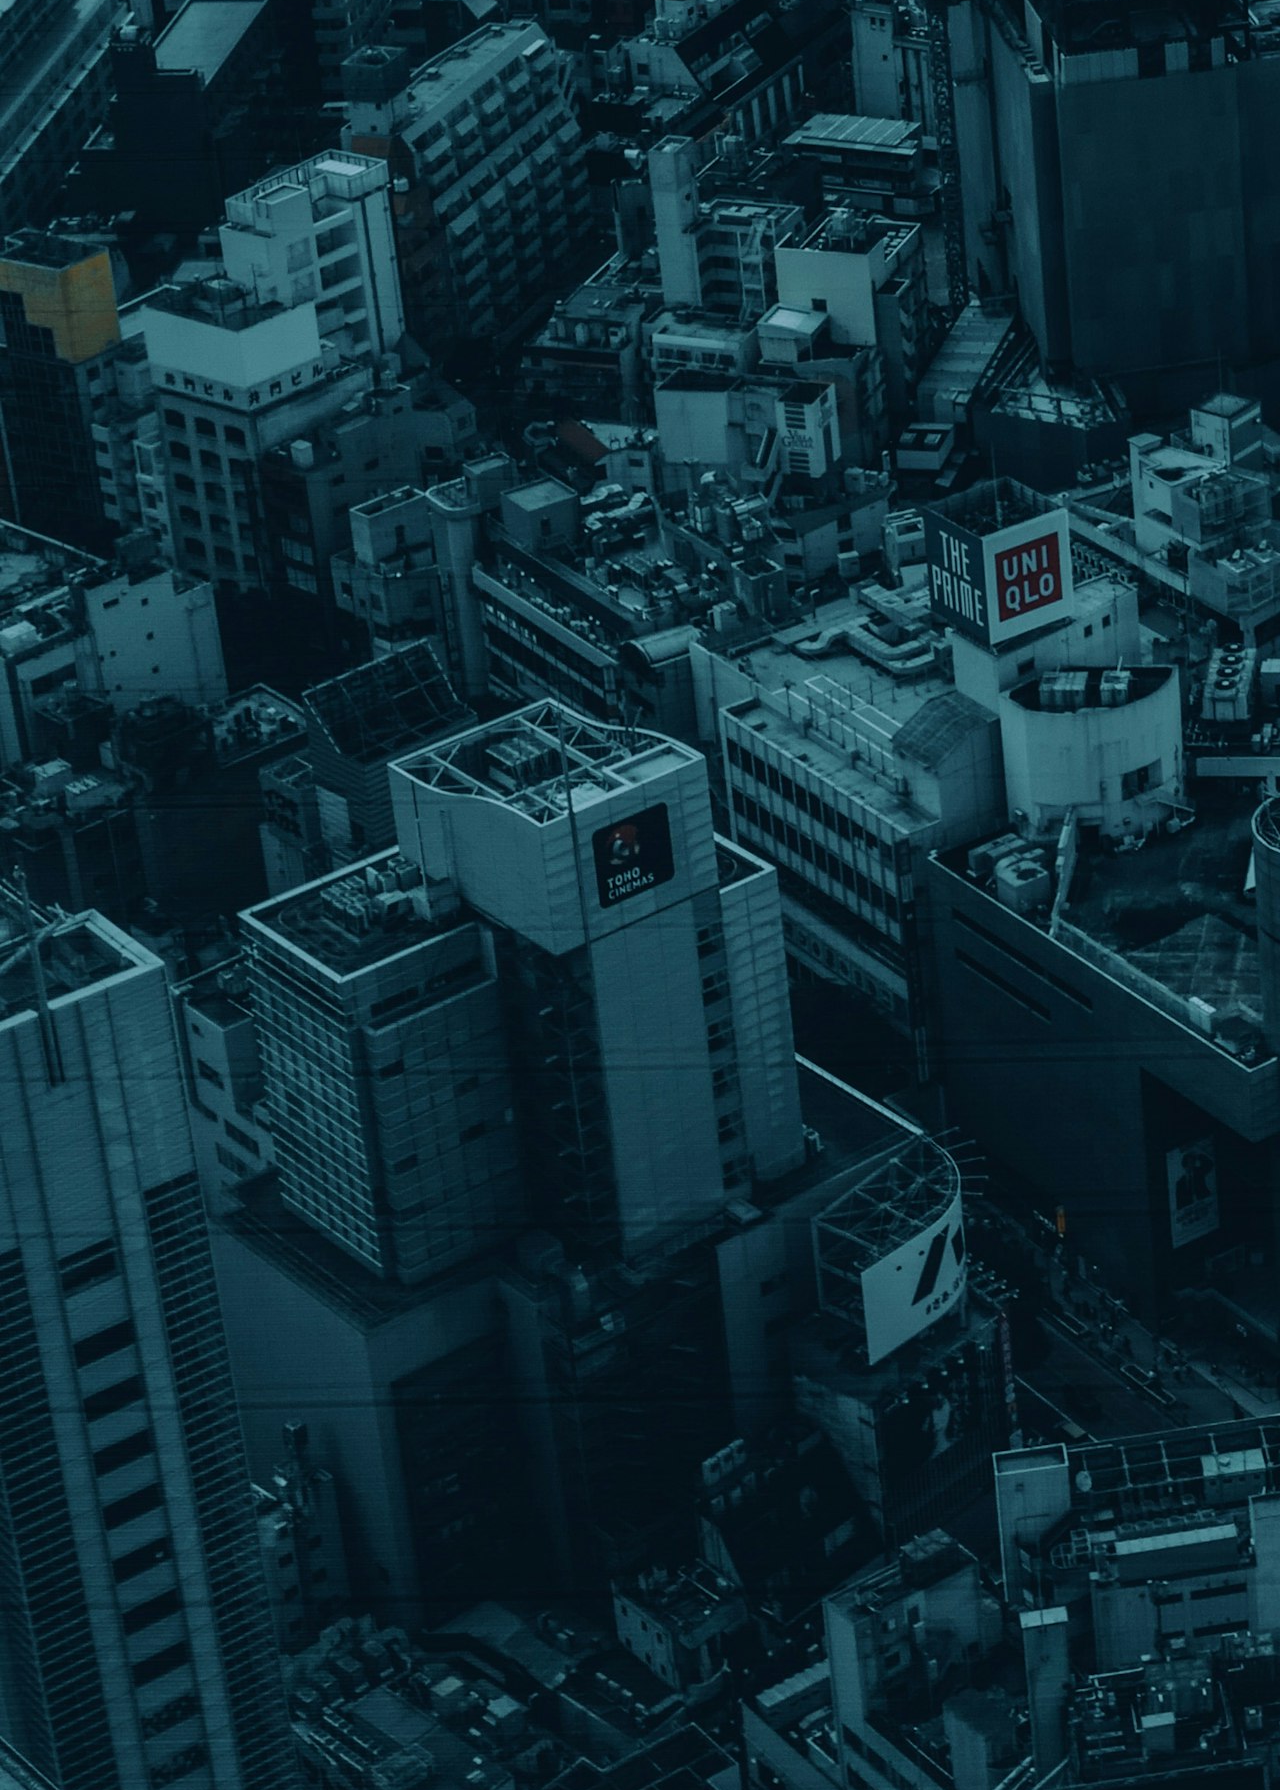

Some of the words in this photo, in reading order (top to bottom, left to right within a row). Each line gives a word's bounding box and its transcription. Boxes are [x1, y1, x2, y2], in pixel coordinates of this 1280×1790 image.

[940, 530, 971, 581] THE
[1002, 544, 1049, 580] UNI
[932, 564, 986, 627] PRIME
[1006, 572, 1055, 611] QLO
[607, 867, 640, 890] TOHO
[608, 873, 655, 900] CINEMAS
